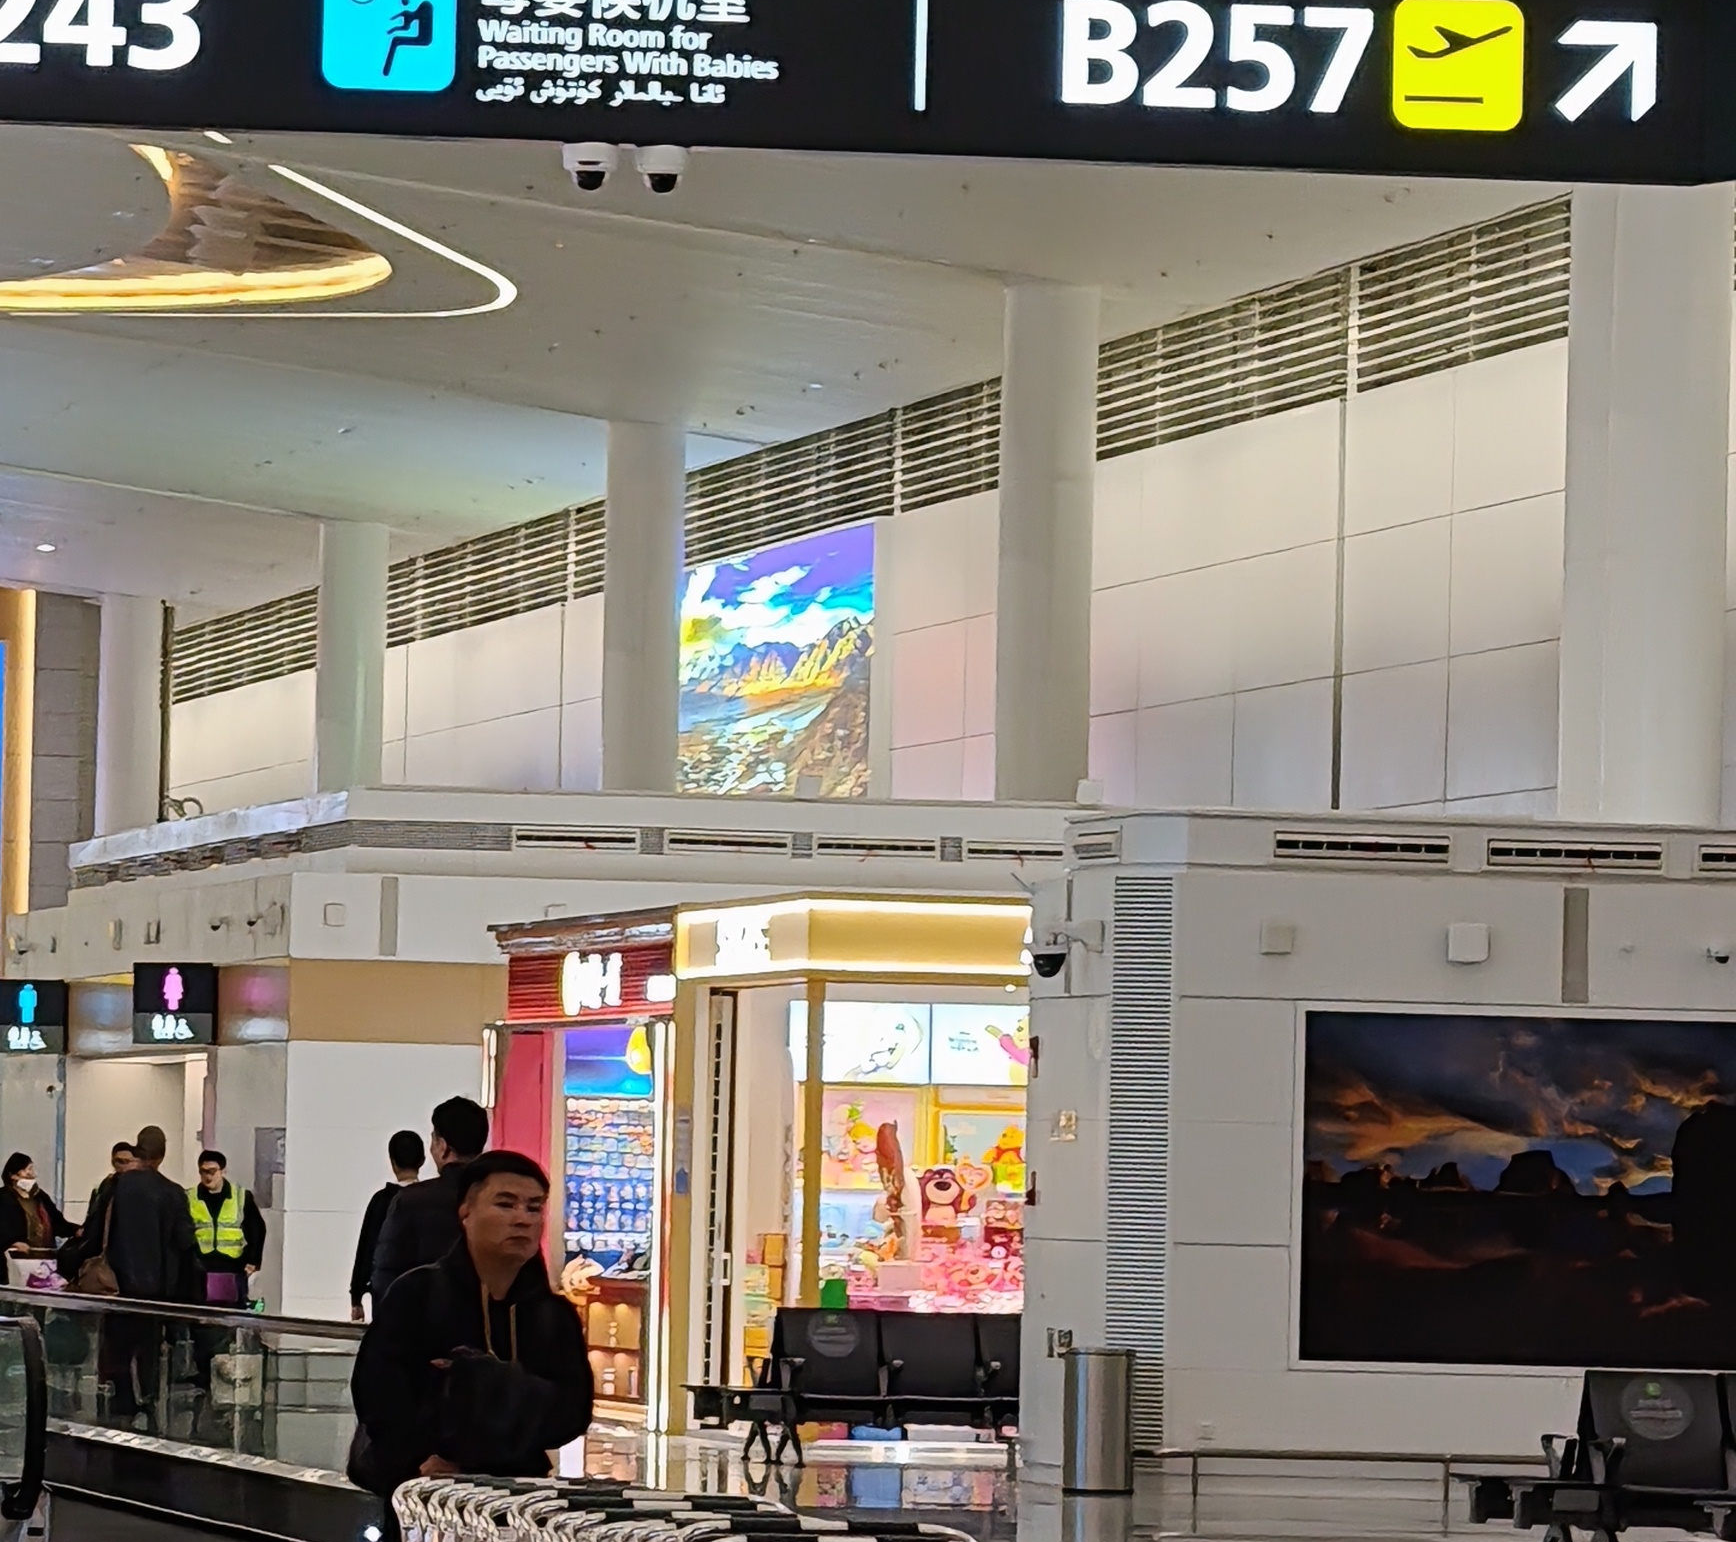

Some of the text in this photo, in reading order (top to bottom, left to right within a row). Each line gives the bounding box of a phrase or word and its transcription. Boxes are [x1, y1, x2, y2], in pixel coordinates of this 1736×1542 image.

[477, 19, 713, 52] Waiting Room for
[477, 45, 780, 79] Passengers With Babies
